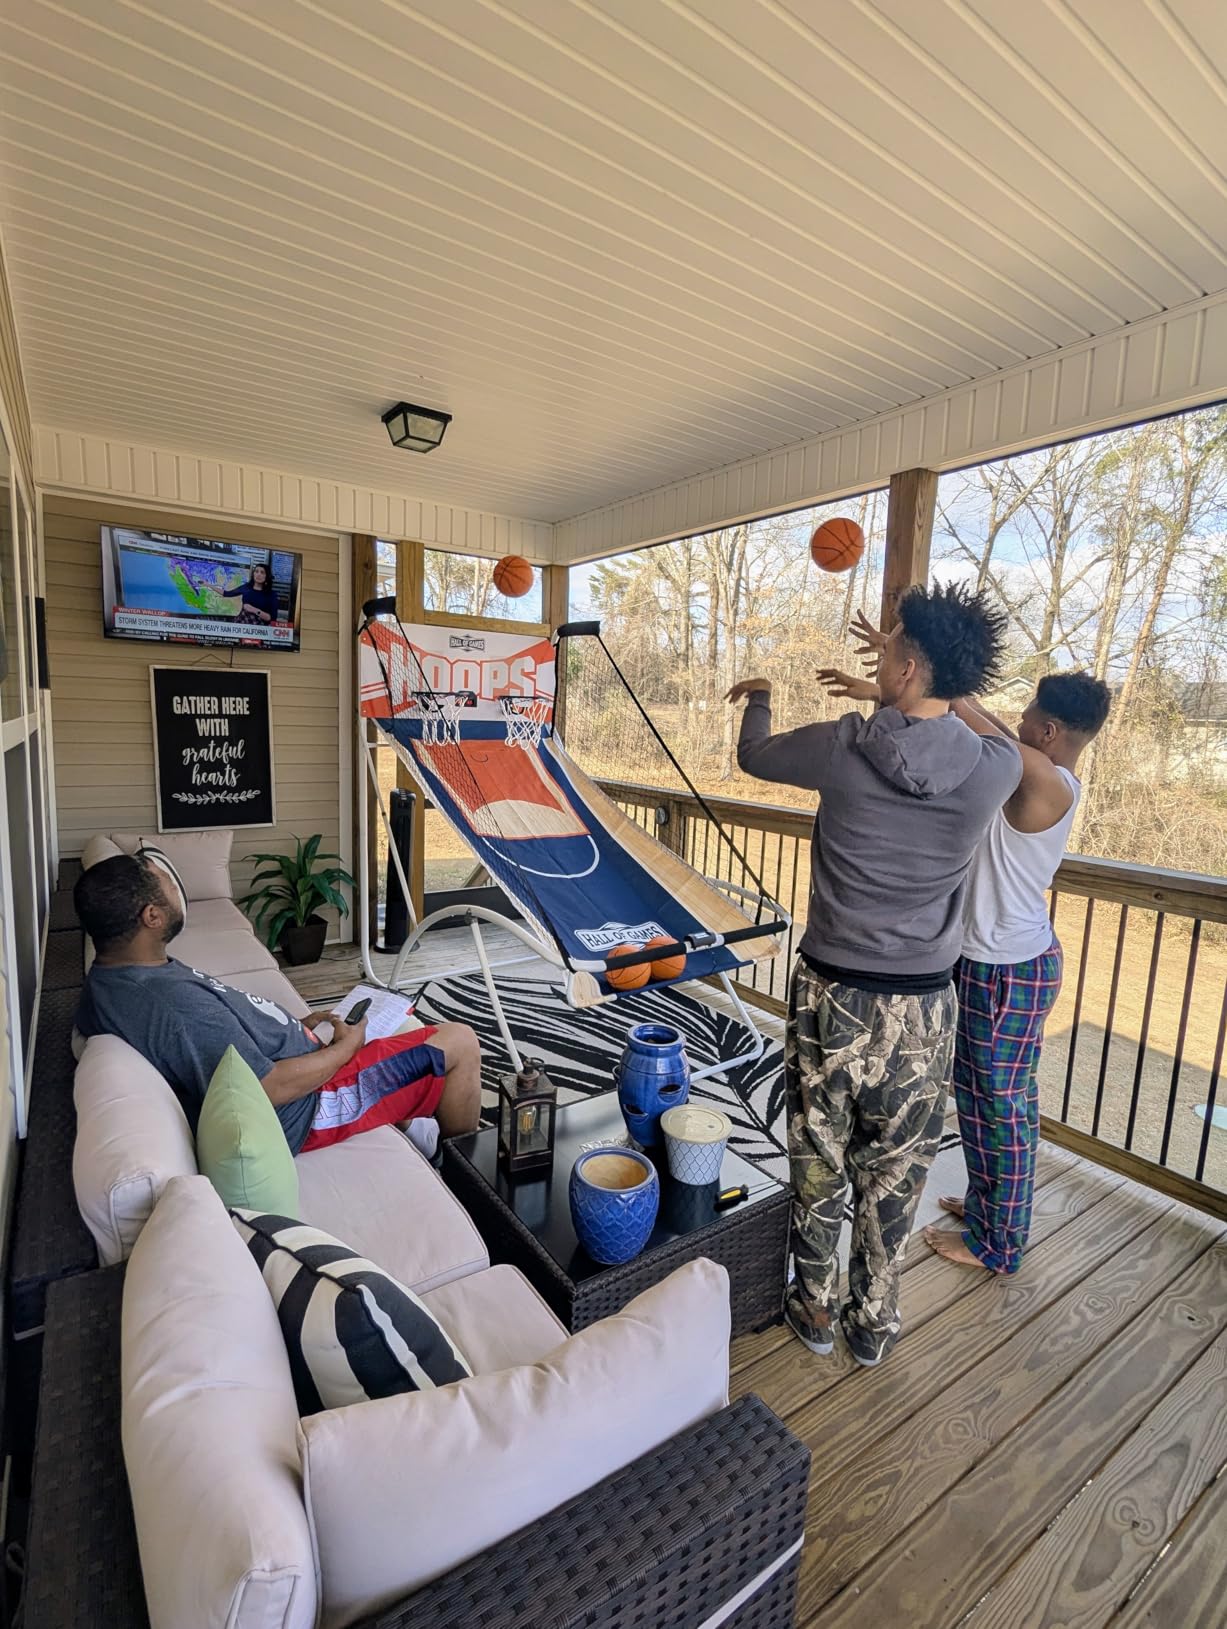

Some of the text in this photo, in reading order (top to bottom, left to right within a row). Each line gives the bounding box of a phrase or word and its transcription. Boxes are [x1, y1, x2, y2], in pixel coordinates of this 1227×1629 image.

[142, 609, 167, 617] WALLOP
[118, 616, 137, 624] STORM
[138, 618, 158, 627] SYSTEM
[159, 620, 188, 630] THREATENS
[189, 623, 204, 631] MORE
[204, 624, 219, 632] HEAVY
[232, 626, 241, 634] FOR
[242, 627, 269, 636] CALIFORNIA
[273, 628, 290, 638] CNN
[451, 637, 485, 649] HALL OF GAMES
[390, 642, 537, 702] HOOPS
[172, 695, 250, 715] GATHER HERE
[195, 718, 229, 737] WITH
[182, 739, 246, 765] grateful
[191, 763, 241, 787] hearts
[581, 926, 664, 948] HALL OF GAMES
